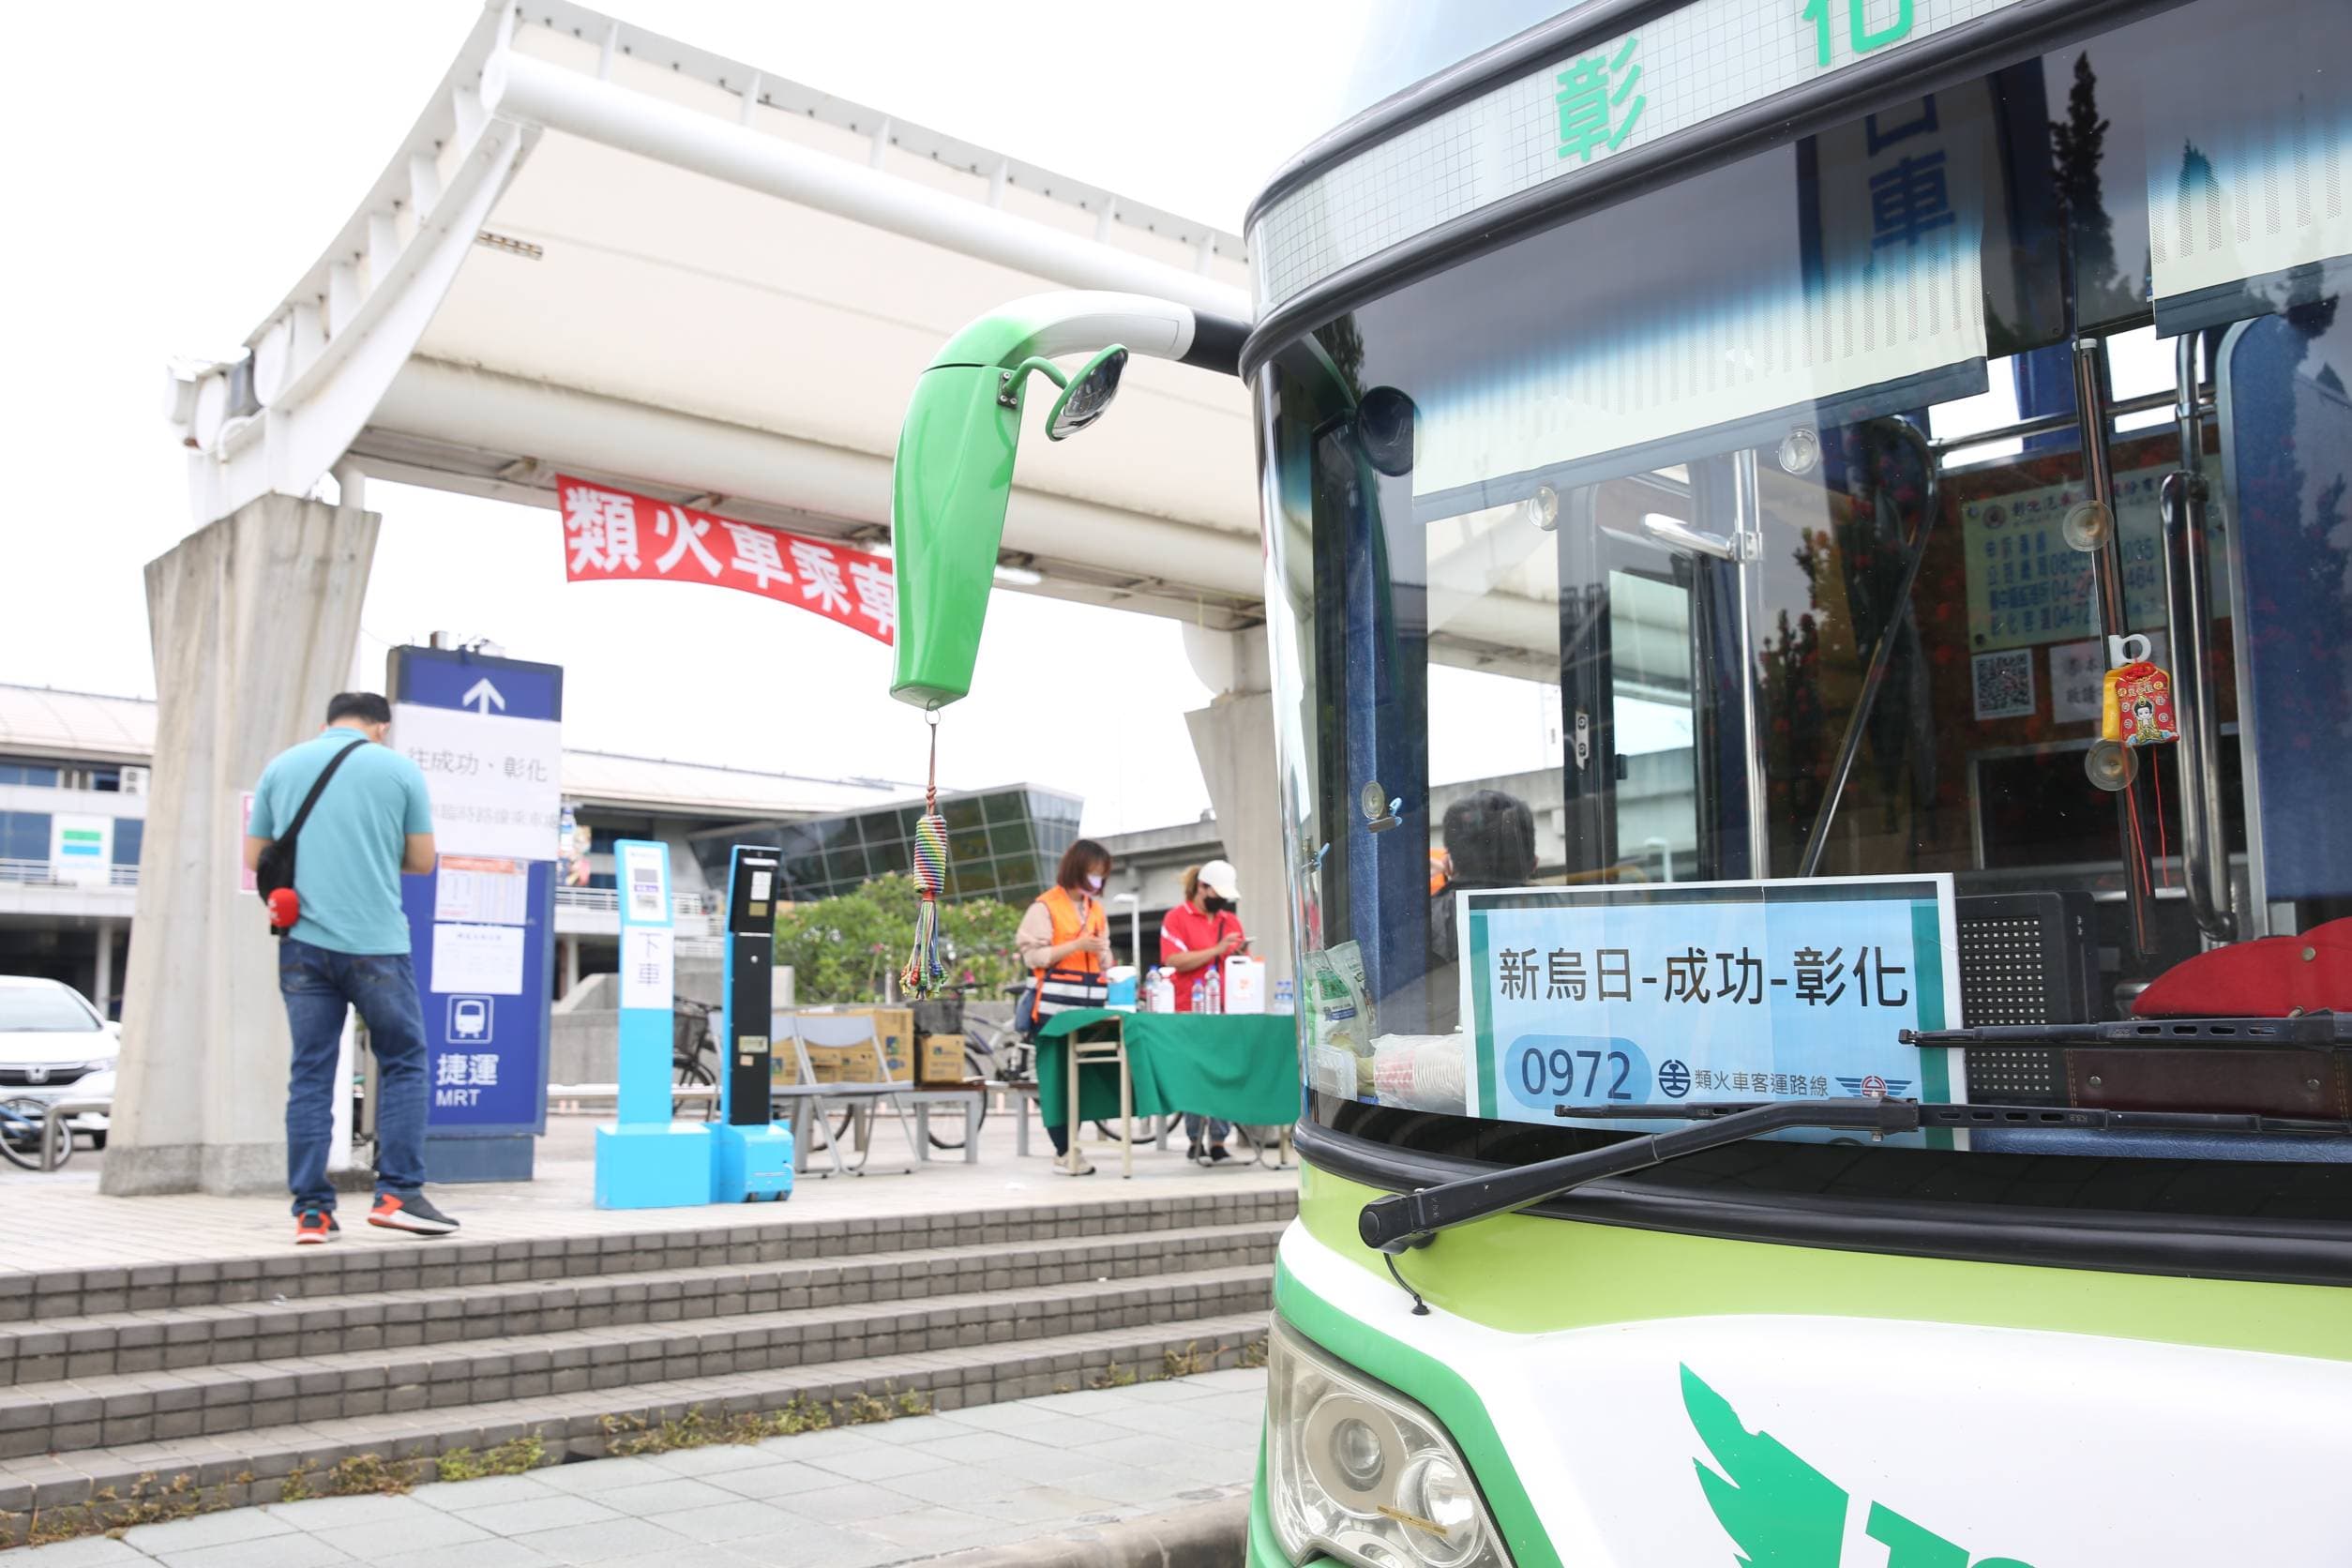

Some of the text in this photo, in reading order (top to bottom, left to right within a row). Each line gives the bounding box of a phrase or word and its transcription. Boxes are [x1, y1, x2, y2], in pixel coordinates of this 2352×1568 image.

[565, 487, 893, 636] 類火車乘車
[638, 932, 662, 987] 下車
[1500, 946, 1908, 1007] 新烏日-成功-彰化
[436, 1053, 499, 1086] 捷運
[1521, 1047, 1632, 1100] 0972
[1695, 1069, 1829, 1097] 類火車客運路線
[436, 1089, 481, 1107] MRT
